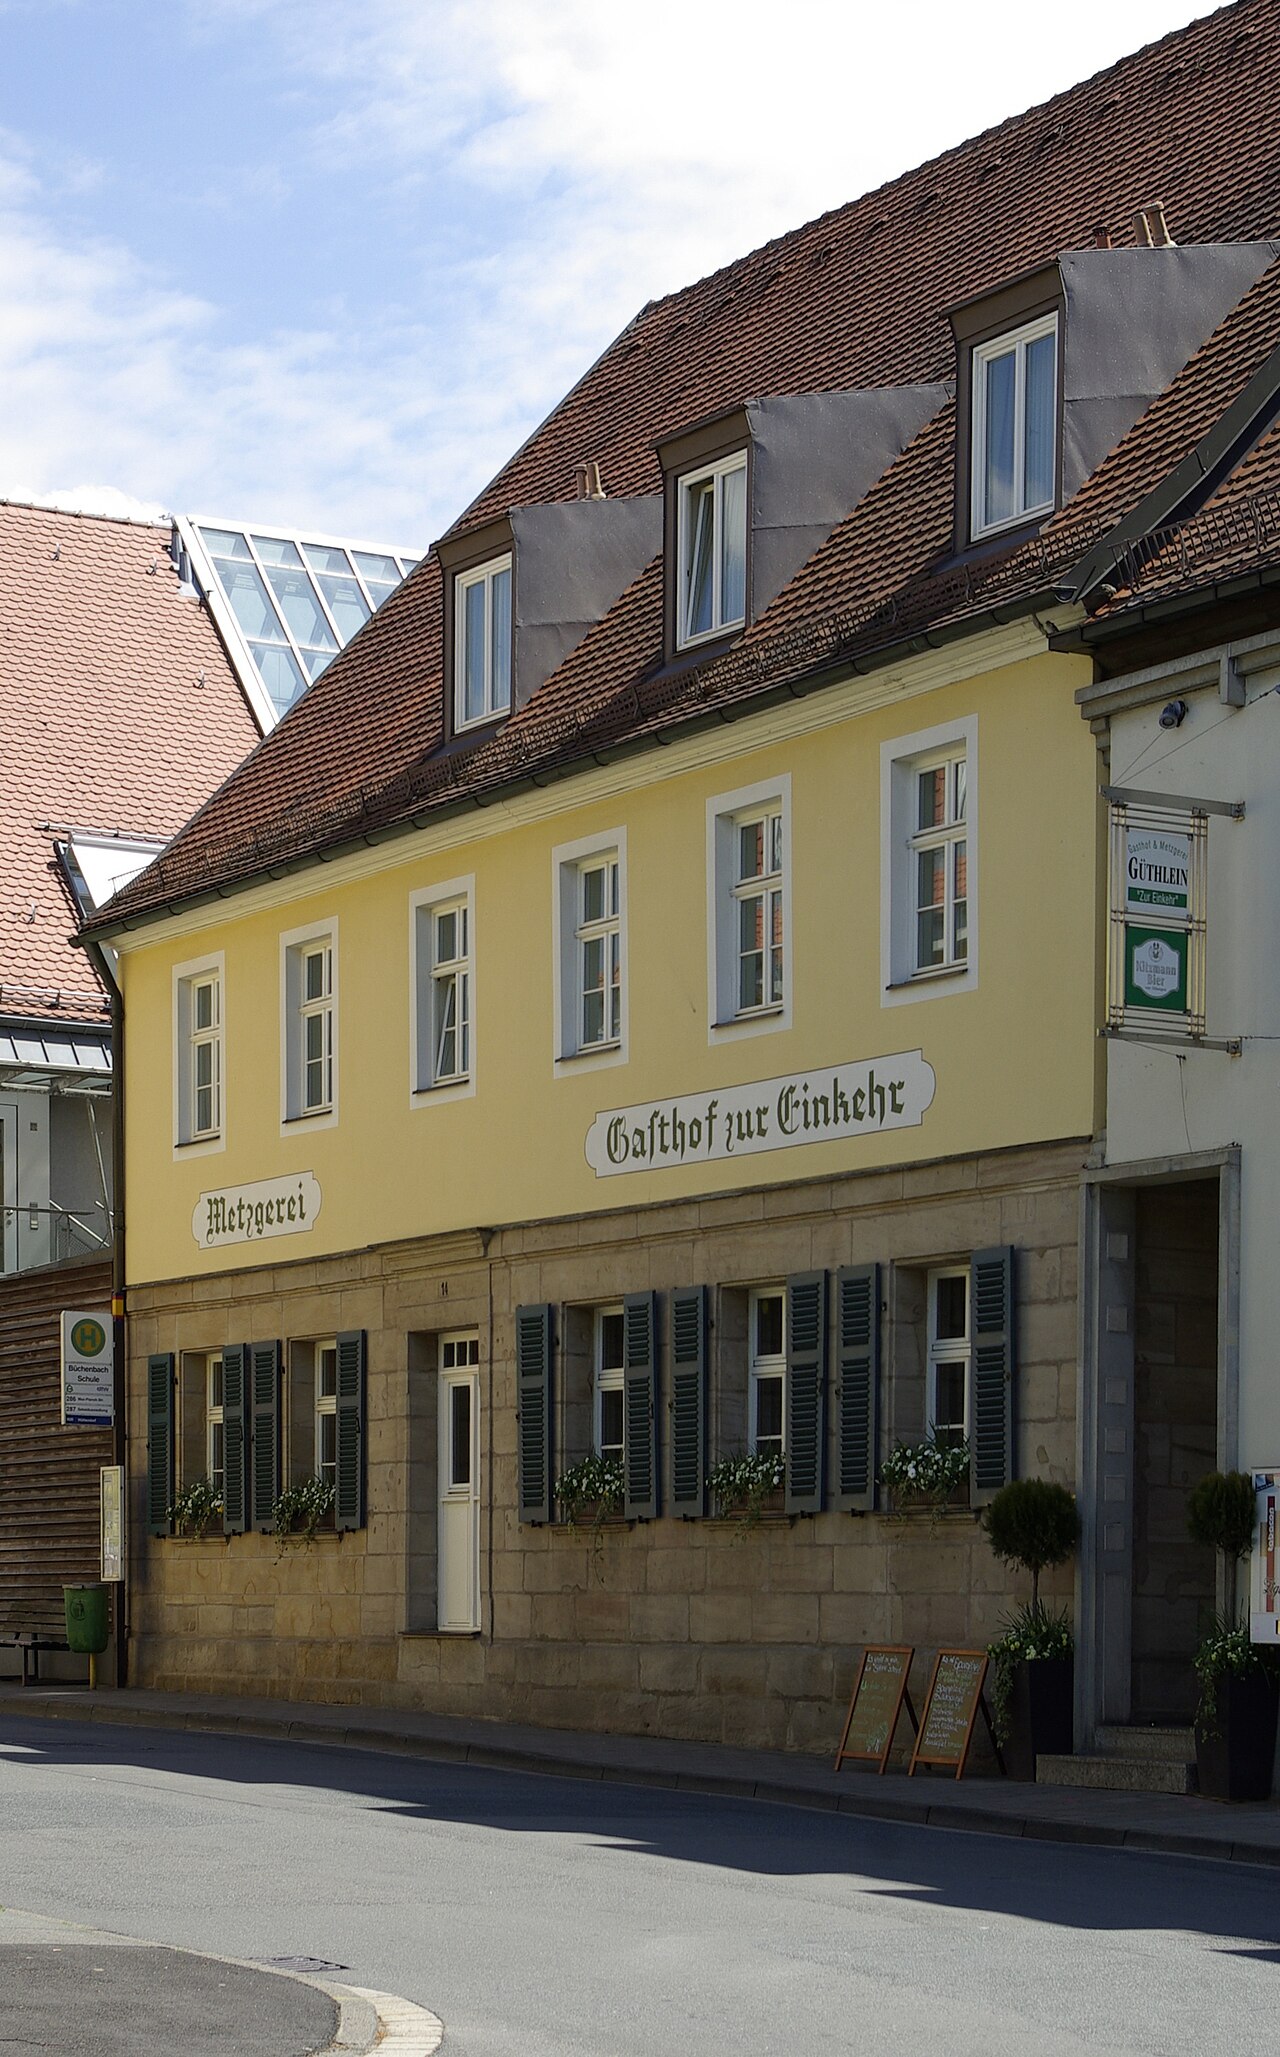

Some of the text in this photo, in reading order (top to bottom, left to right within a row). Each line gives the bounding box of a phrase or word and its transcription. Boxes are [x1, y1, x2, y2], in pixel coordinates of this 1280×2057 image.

[1128, 840, 1151, 854] Gasthof
[1153, 840, 1158, 850] &
[1128, 856, 1188, 887] GÜTHLEIN
[1147, 974, 1165, 986] Bier
[725, 1105, 770, 1153] zur
[777, 1069, 905, 1136] Einkehr
[206, 1180, 307, 1244] Metzgerei
[80, 1327, 96, 1348] H
[68, 1364, 109, 1374] Büchenbach
[77, 1375, 100, 1383] Schule
